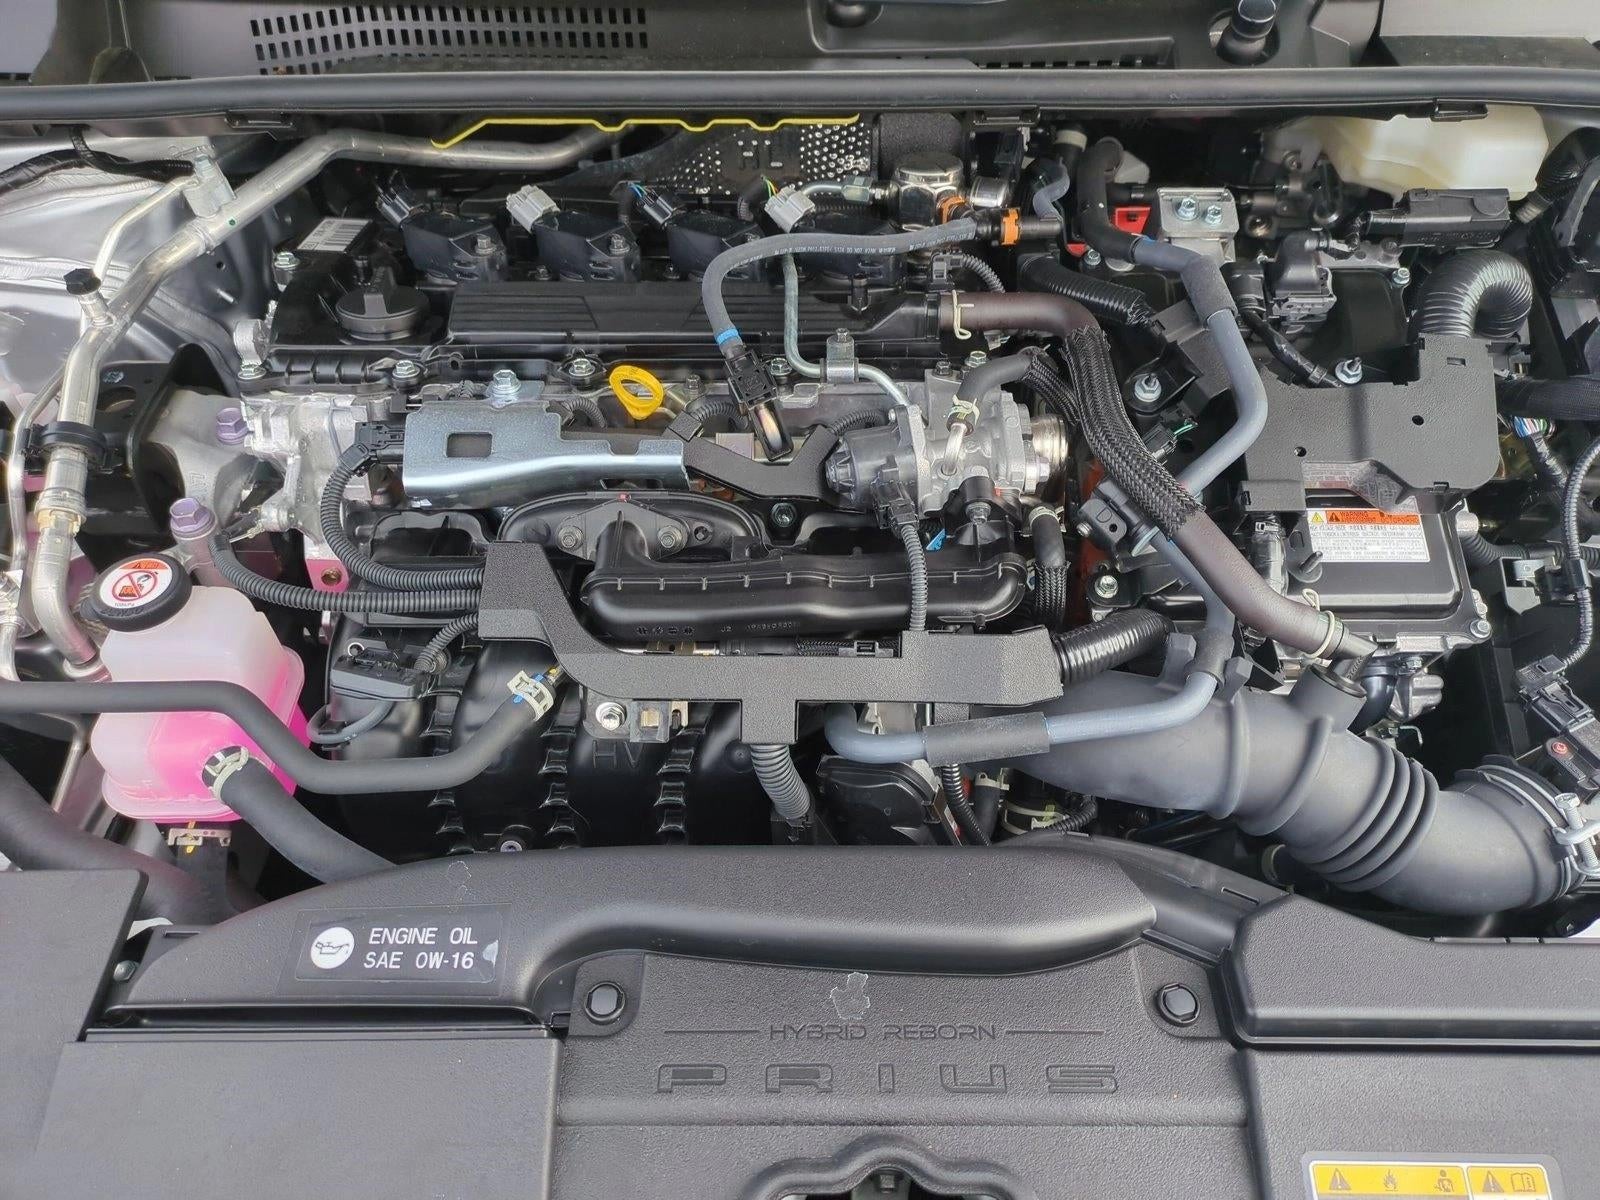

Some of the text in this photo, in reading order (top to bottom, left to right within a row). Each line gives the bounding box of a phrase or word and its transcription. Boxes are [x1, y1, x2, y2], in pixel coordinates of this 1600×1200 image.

[369, 927, 478, 945] ENGINE OIL
[363, 950, 475, 970] SAE 0W-16
[769, 1023, 996, 1041] HYBRID REBORN
[656, 1062, 1119, 1094] PRIUS
